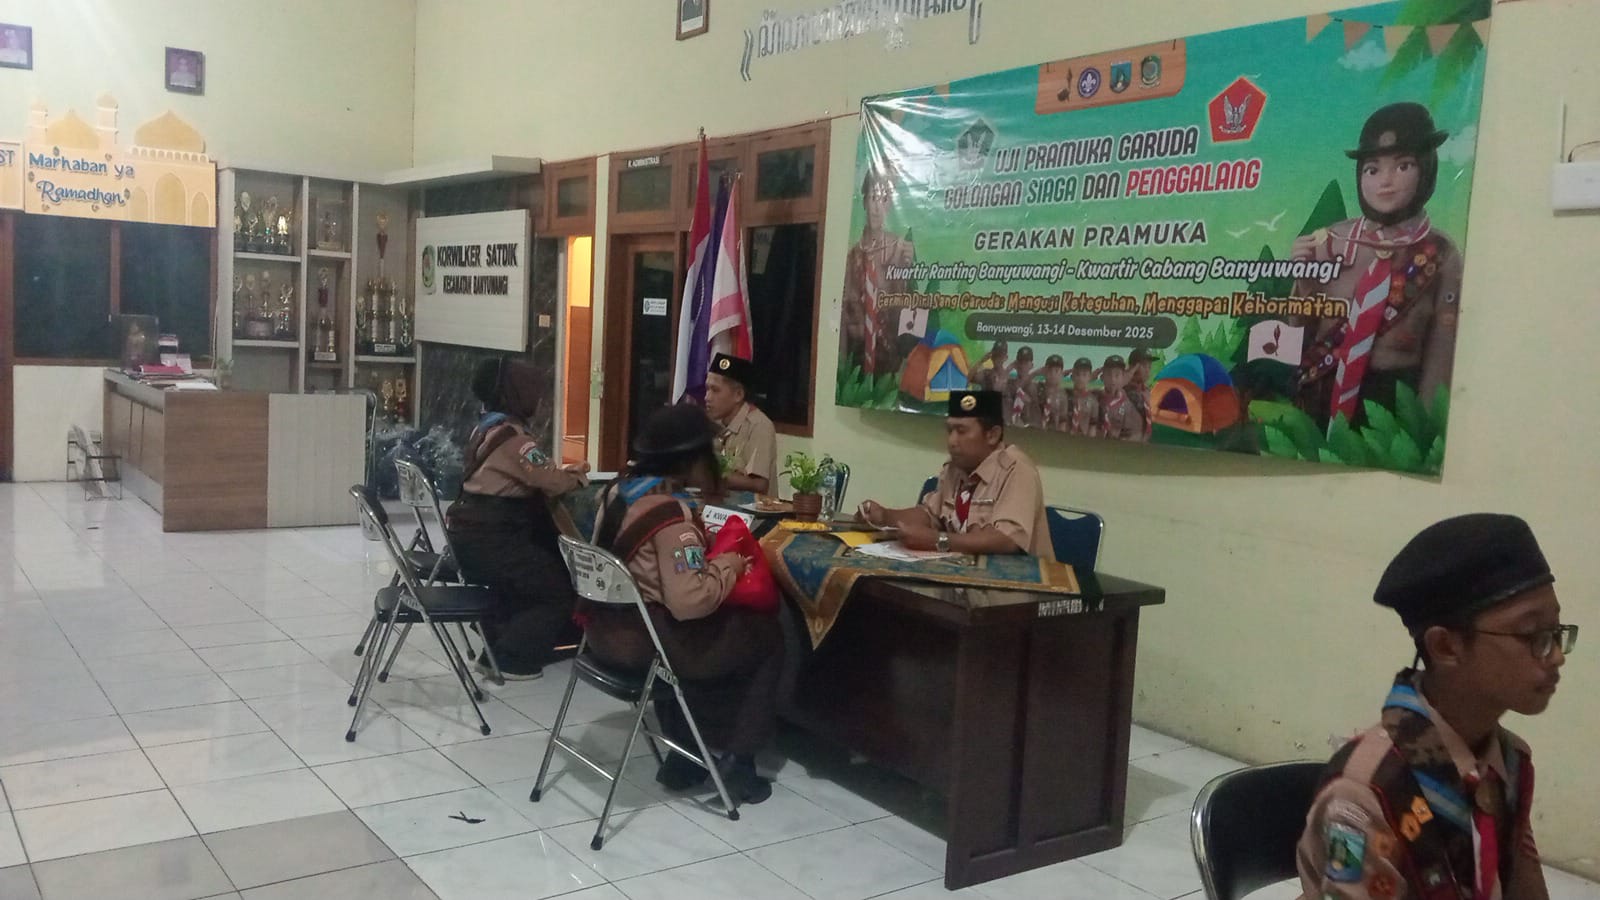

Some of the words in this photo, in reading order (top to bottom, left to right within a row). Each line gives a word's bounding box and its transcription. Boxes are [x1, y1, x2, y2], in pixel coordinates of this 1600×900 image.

[995, 149, 1020, 173] UJI
[1024, 137, 1113, 172] PRAMUKA
[1118, 126, 1199, 161] GARUDA
[29, 152, 108, 174] Marhaban
[115, 165, 135, 179] ya
[36, 180, 125, 206] Ramadhan
[944, 181, 1022, 210] GOLONGAN
[1026, 176, 1077, 204] SIAGA
[1081, 173, 1121, 200] DAN
[1125, 160, 1261, 198] PENGGALANG
[974, 227, 1075, 251] GERAKAN
[1083, 222, 1207, 248] PRAMUKA
[437, 245, 481, 267] KORWILKER
[486, 243, 518, 267] SATDIK
[886, 263, 928, 280] Kwartir
[929, 262, 977, 284] Ranting
[979, 259, 1066, 284] Banyuwangi
[1076, 258, 1139, 280] Kwartir
[1141, 257, 1207, 283] Cabang
[1211, 256, 1343, 284] Banyuwangi
[933, 291, 959, 310] Sang
[1007, 292, 1060, 312] Menguji
[1061, 291, 1139, 314] Keteguhan,
[1141, 292, 1229, 317] Menggapai
[1231, 292, 1349, 318] Kehormatan
[976, 321, 1034, 337] Banyuwangi,
[1037, 323, 1066, 335] 13-14
[1067, 324, 1122, 338] Desember
[1124, 326, 1154, 340] 2025
